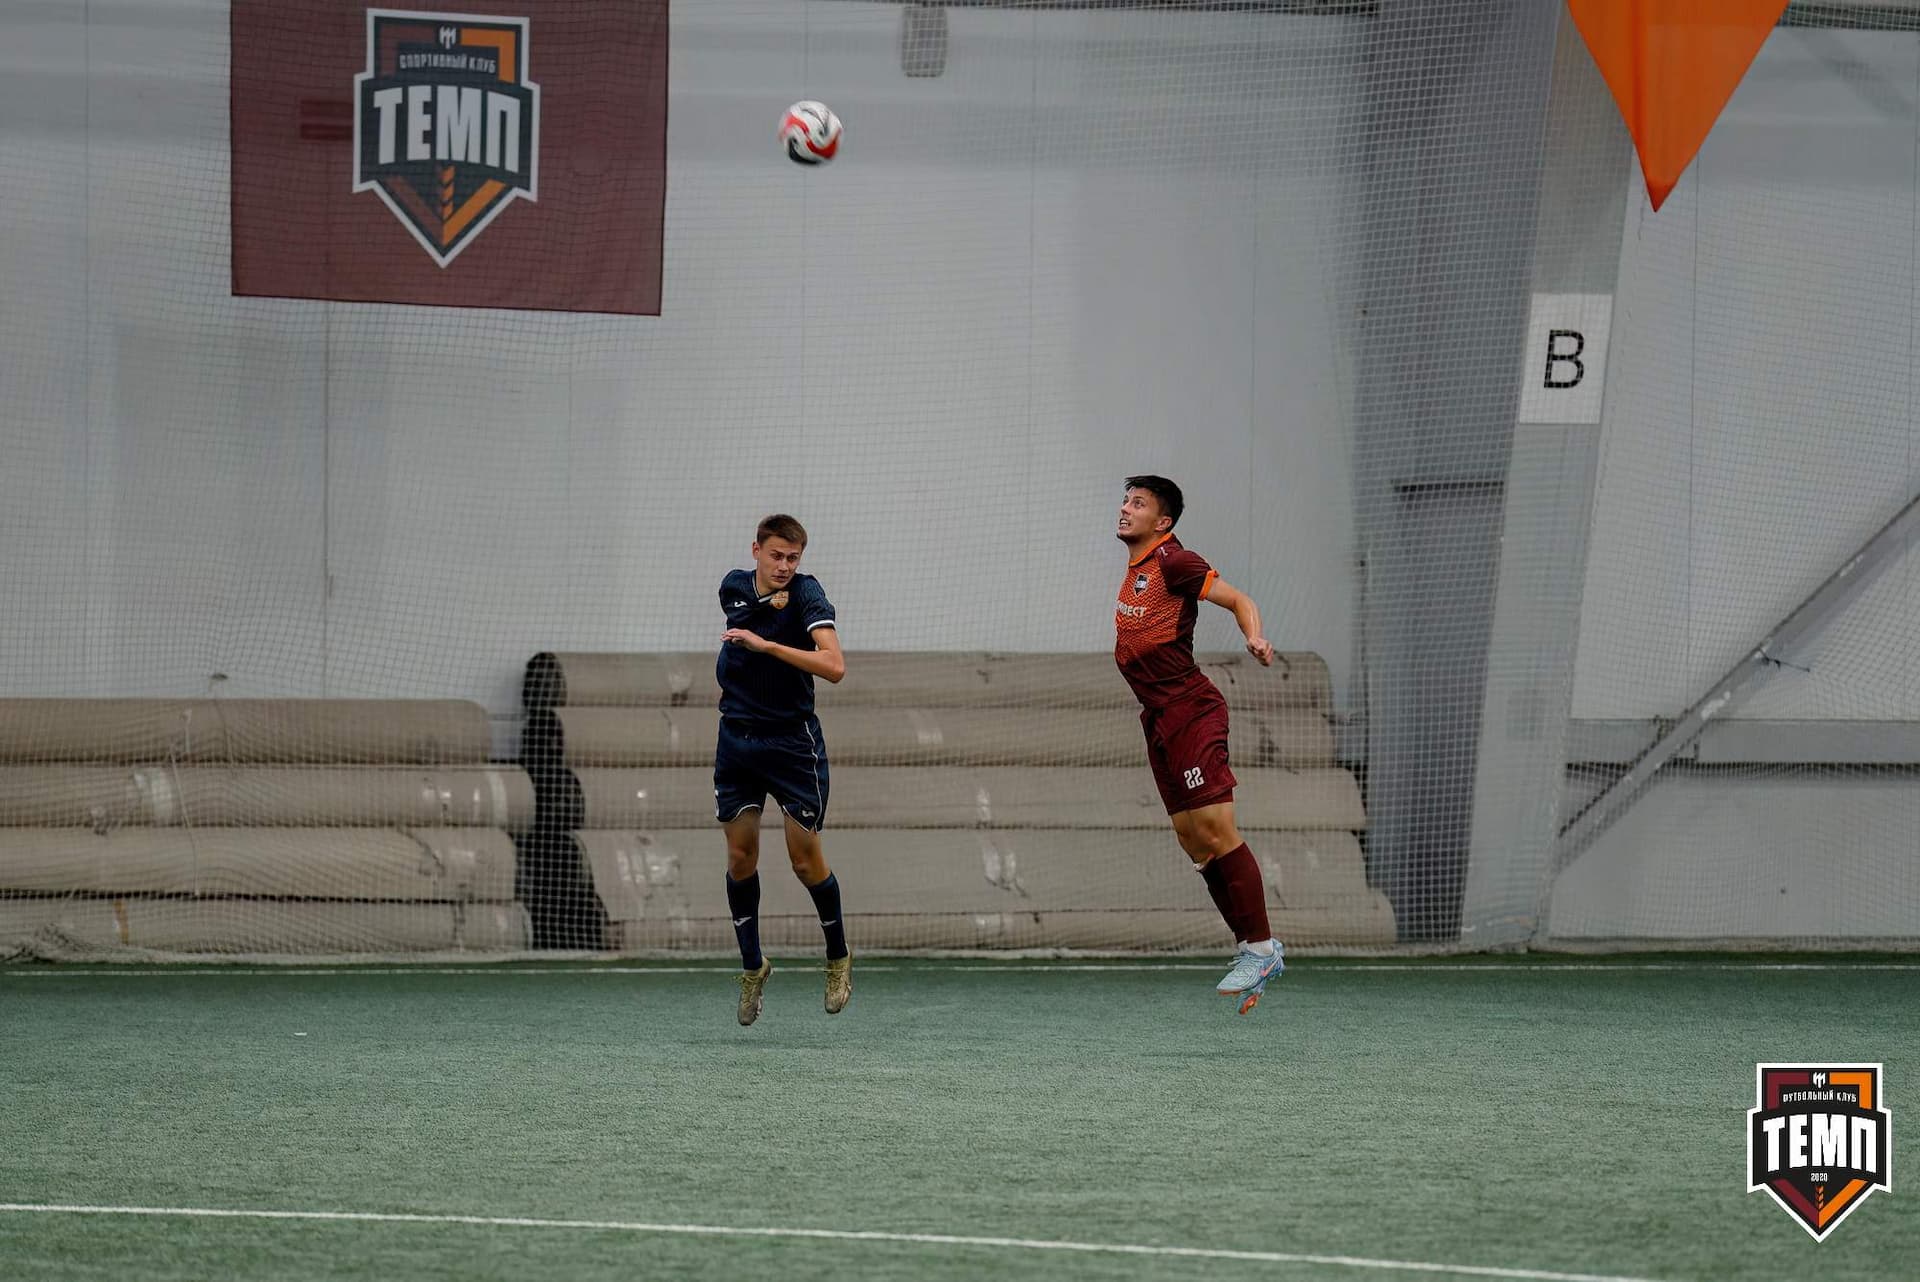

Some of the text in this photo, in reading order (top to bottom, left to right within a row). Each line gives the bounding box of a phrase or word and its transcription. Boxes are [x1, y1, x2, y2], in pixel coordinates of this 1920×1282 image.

[399, 53, 496, 74] СПОРТИВНЫЙ КЛУБ
[373, 84, 521, 174] ТЕМП
[1183, 766, 1205, 790] 22
